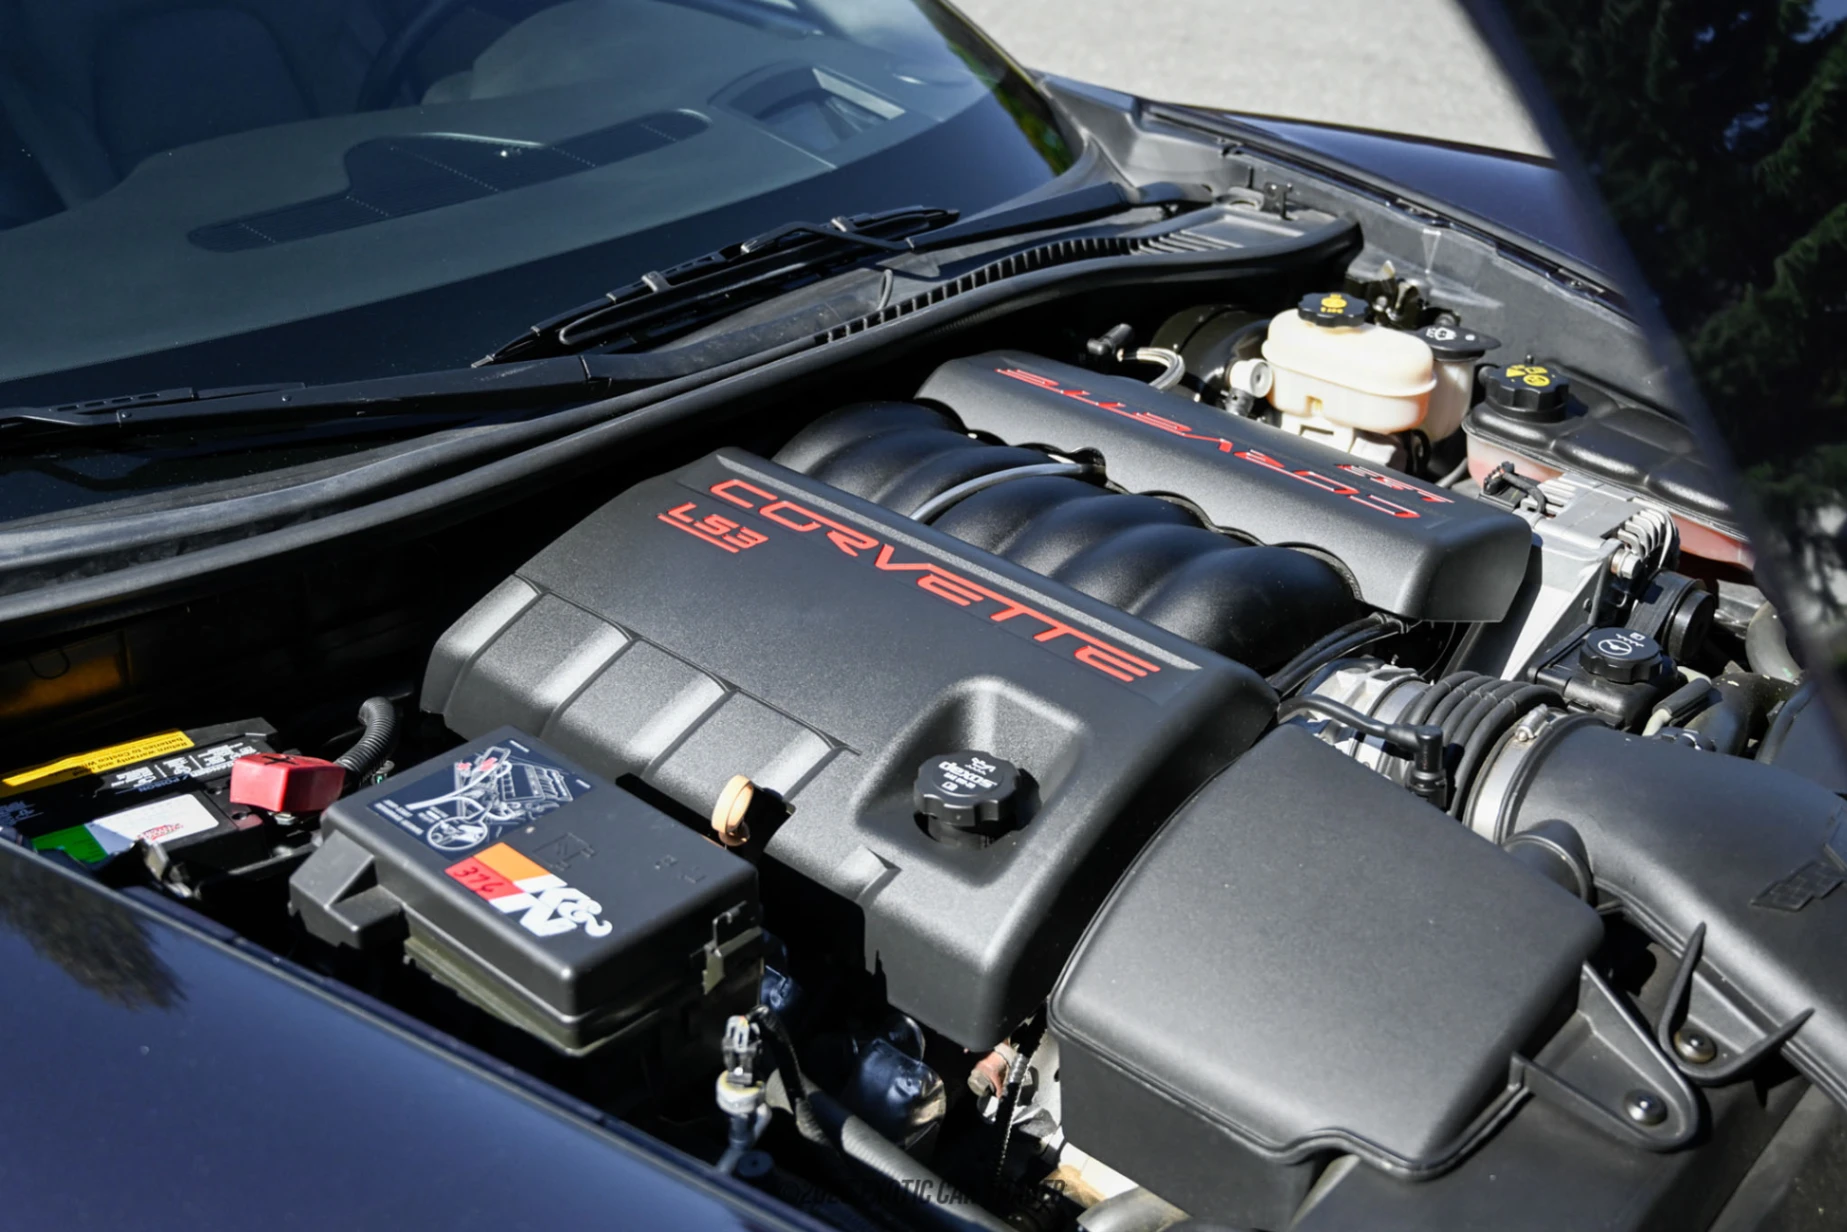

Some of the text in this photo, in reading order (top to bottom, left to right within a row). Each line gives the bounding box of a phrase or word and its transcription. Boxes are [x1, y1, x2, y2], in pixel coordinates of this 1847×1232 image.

[994, 368, 1420, 519] CORVETTE
[1336, 464, 1455, 504] LS3
[668, 501, 770, 550] LS3
[709, 478, 1161, 683] CORVETTE
